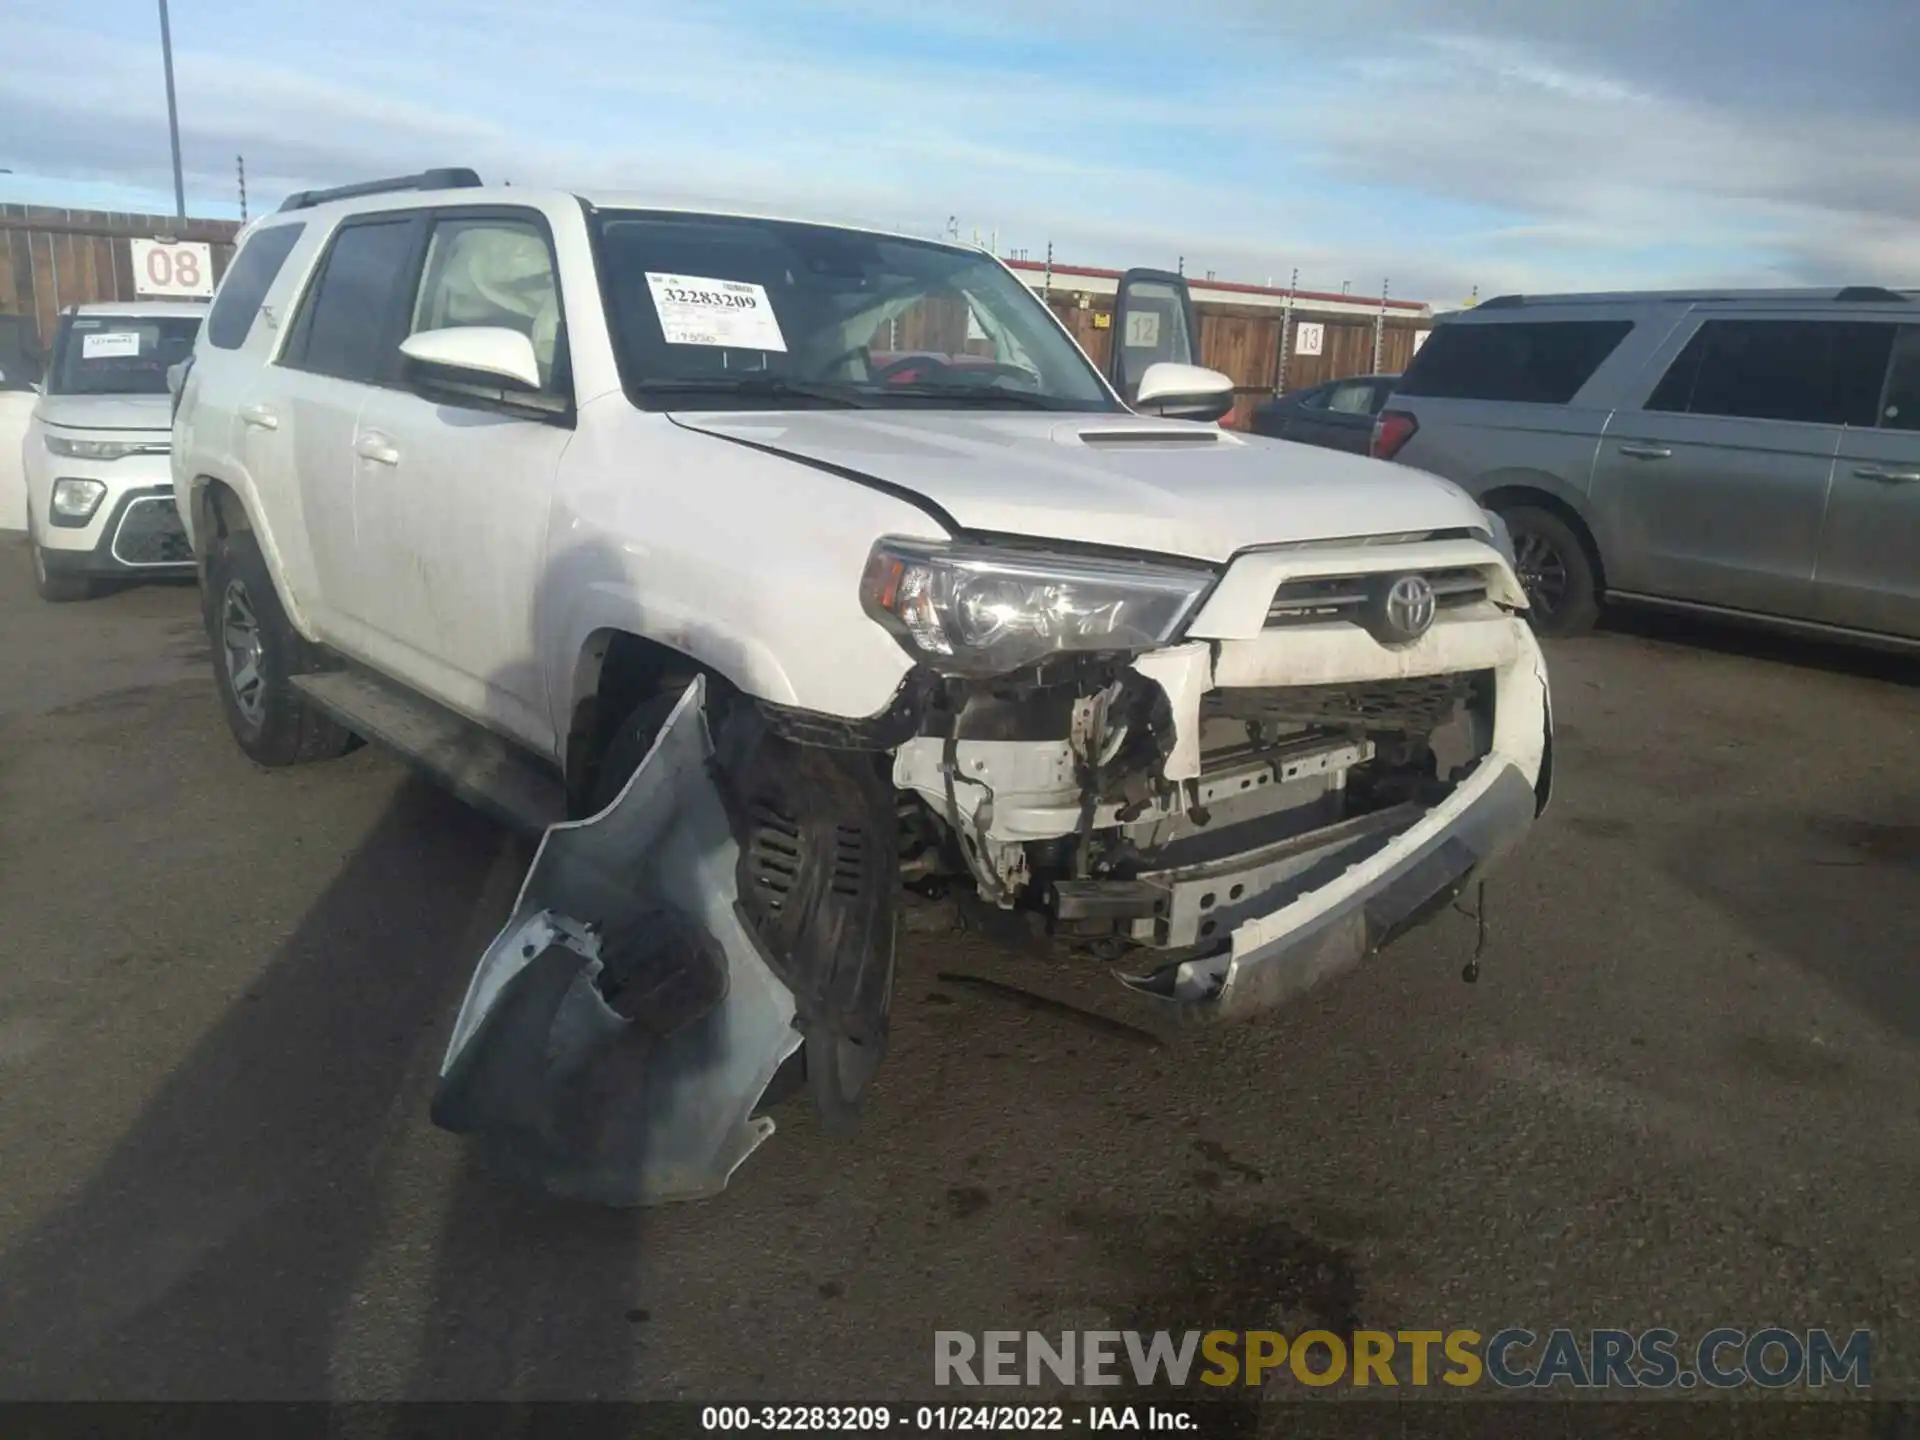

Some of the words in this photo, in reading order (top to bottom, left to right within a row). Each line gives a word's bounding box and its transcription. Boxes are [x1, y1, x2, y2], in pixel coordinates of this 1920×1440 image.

[146, 247, 201, 288] 08
[663, 286, 757, 309] 32283209
[1132, 316, 1154, 342] 12
[1302, 327, 1319, 350] 13
